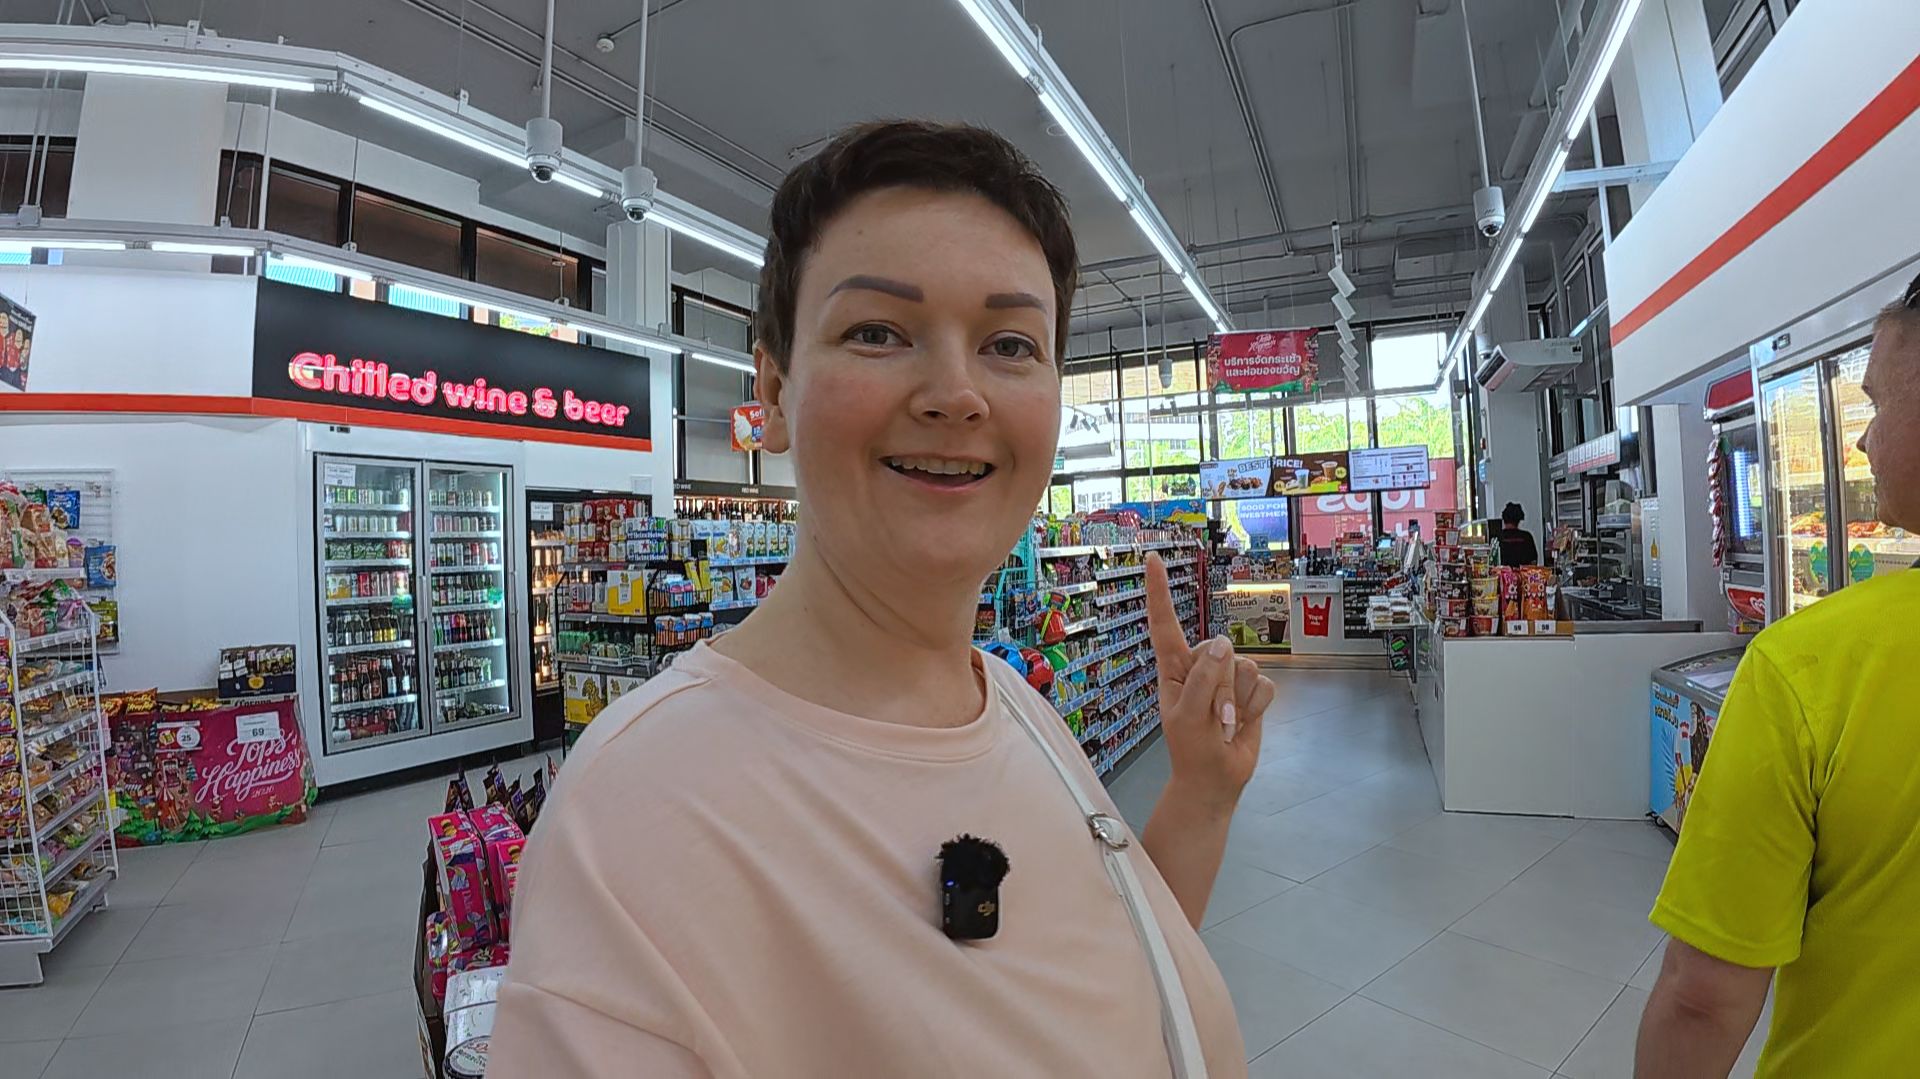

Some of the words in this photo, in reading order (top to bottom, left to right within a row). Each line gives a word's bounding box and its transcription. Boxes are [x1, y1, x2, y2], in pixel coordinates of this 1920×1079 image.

[1224, 353, 1302, 367] บริการจัดกระเช้า
[1225, 365, 1300, 377] และห่อของขวัญ
[288, 352, 438, 405] Chilled
[441, 377, 527, 416] wine
[532, 387, 558, 419] &
[563, 390, 631, 427] beer
[1237, 459, 1267, 473] BEST
[181, 734, 192, 742] 25
[252, 728, 265, 737] 69
[194, 749, 301, 804] Happiness
